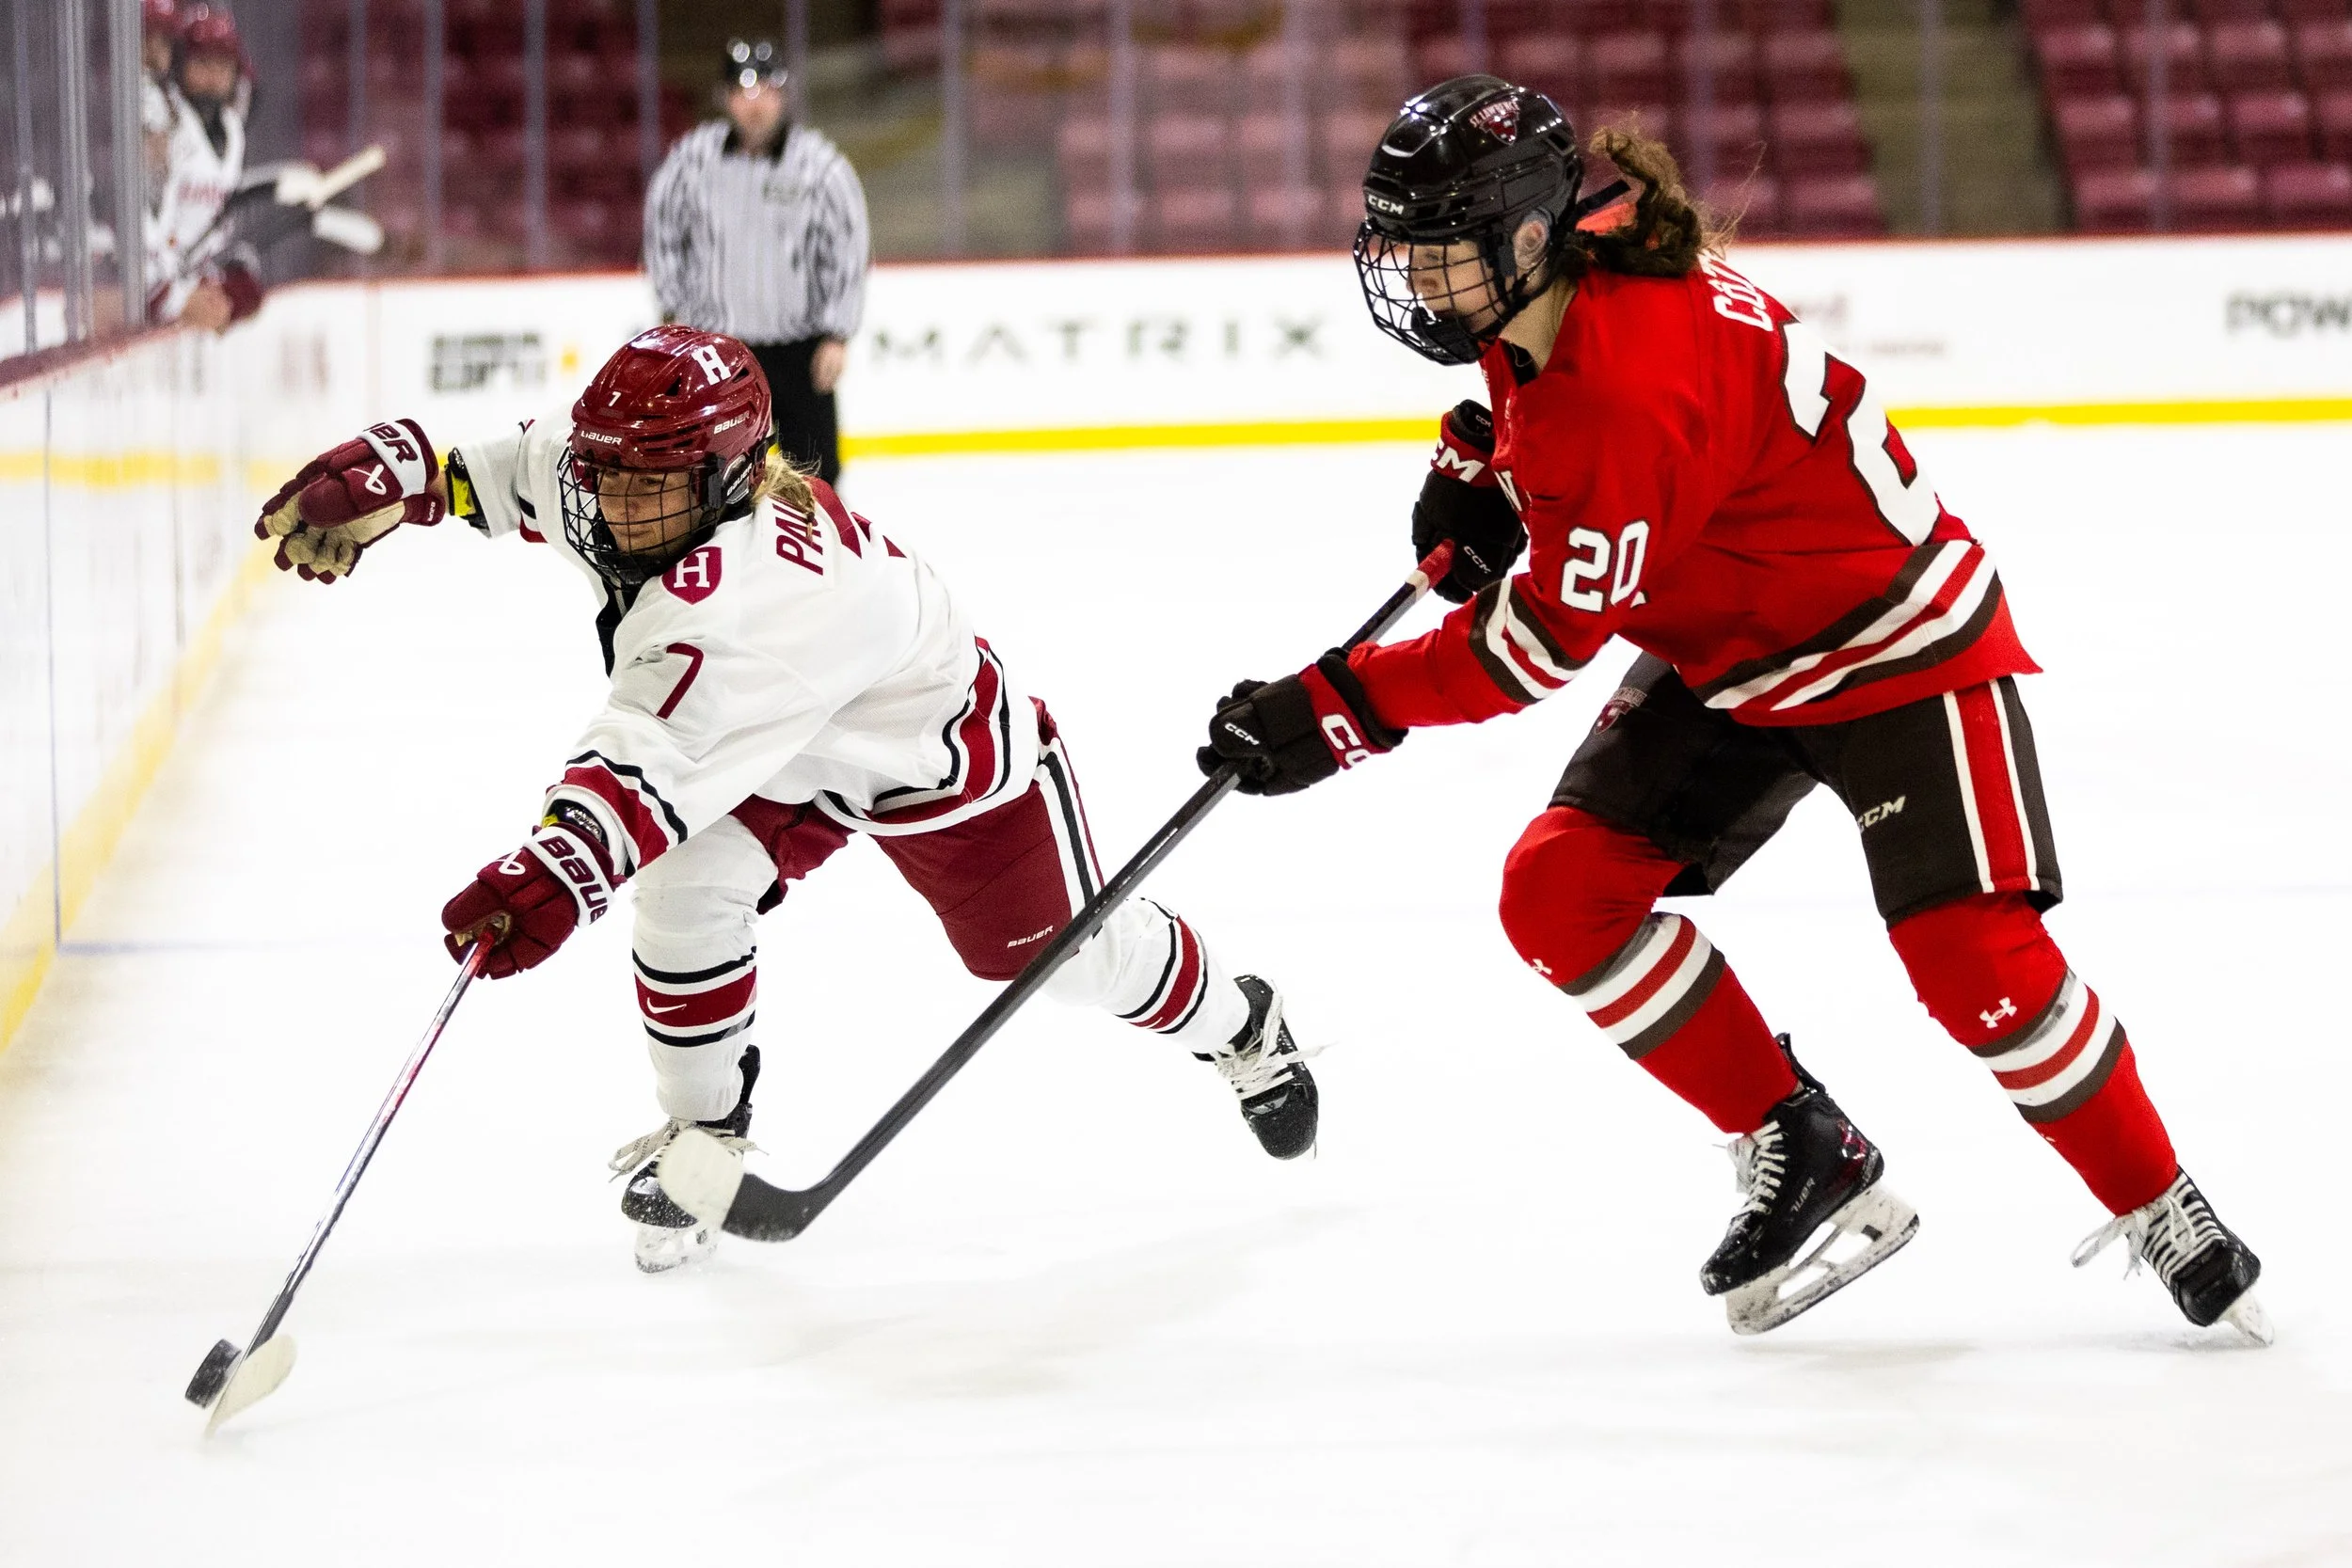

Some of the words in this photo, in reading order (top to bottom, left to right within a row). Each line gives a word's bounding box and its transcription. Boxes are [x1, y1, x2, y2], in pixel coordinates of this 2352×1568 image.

[1367, 194, 1405, 215] CCM
[867, 314, 1328, 366] MATRIX
[691, 344, 732, 386] H
[608, 391, 622, 407] 7
[363, 422, 419, 464] ER
[714, 413, 752, 435] BAUER
[673, 551, 710, 589] H
[1560, 520, 1650, 613] 20
[656, 641, 705, 721] 7
[1224, 721, 1261, 746] CCM
[1007, 925, 1054, 949] BAUER
